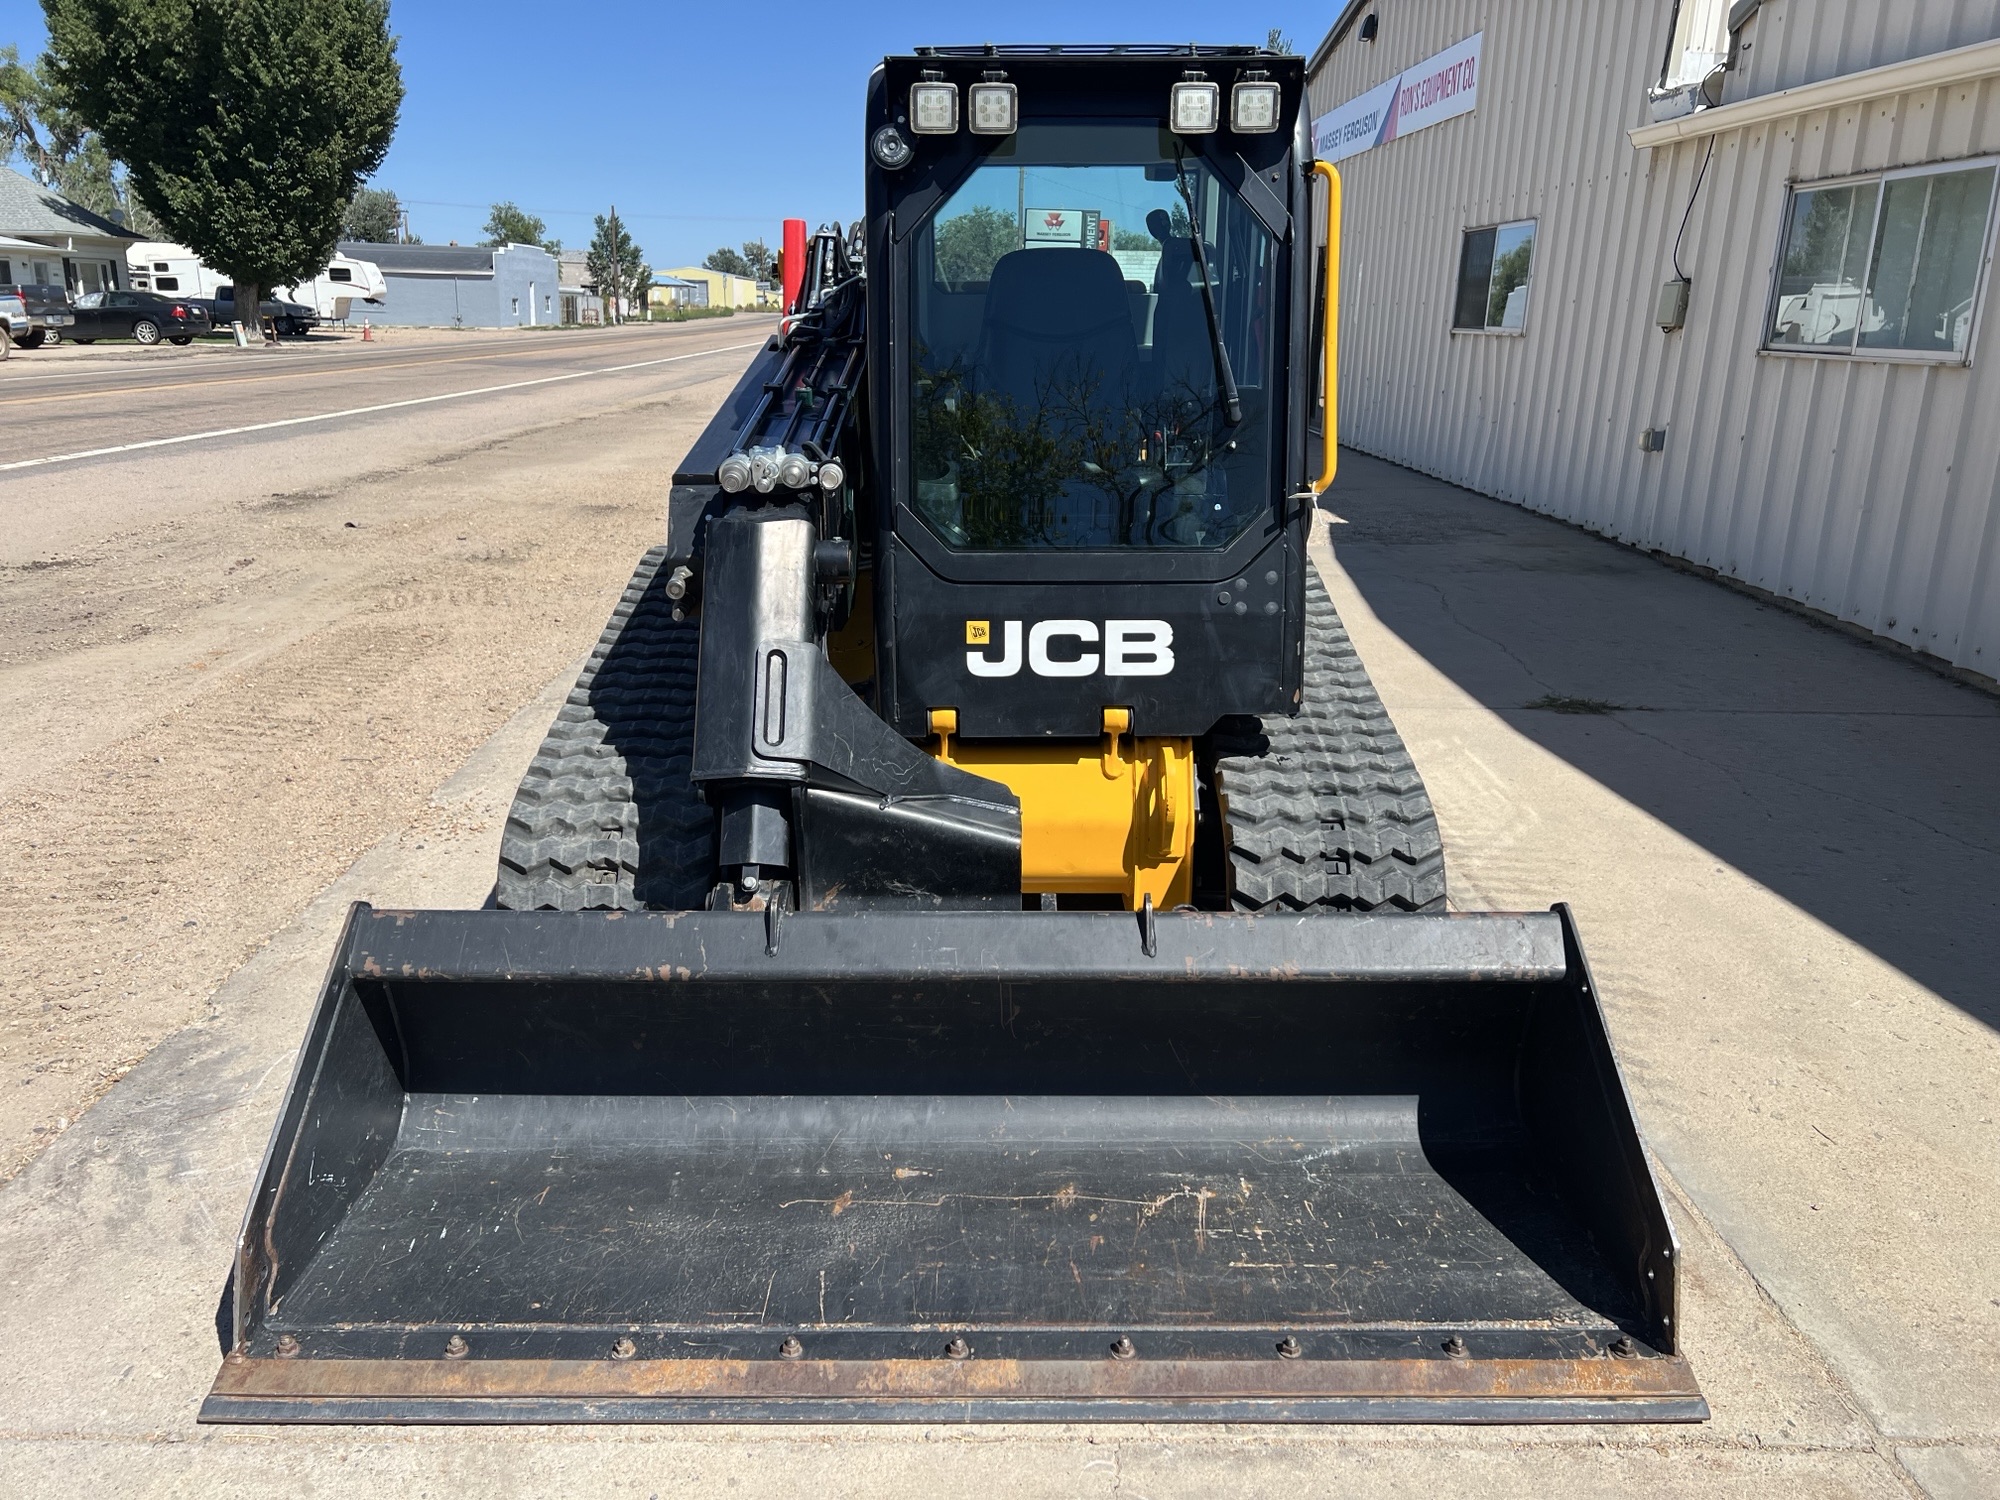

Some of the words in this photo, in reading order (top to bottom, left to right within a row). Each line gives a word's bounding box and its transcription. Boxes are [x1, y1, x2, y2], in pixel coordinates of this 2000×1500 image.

[1400, 81, 1421, 117] RON'S
[1420, 62, 1463, 109] EQUIPMENT
[1463, 56, 1475, 91] CO.
[1319, 127, 1343, 154] MASSEY
[1342, 111, 1378, 144] FERGUSON
[966, 619, 1175, 677] JCB
[972, 626, 986, 638] JCB
